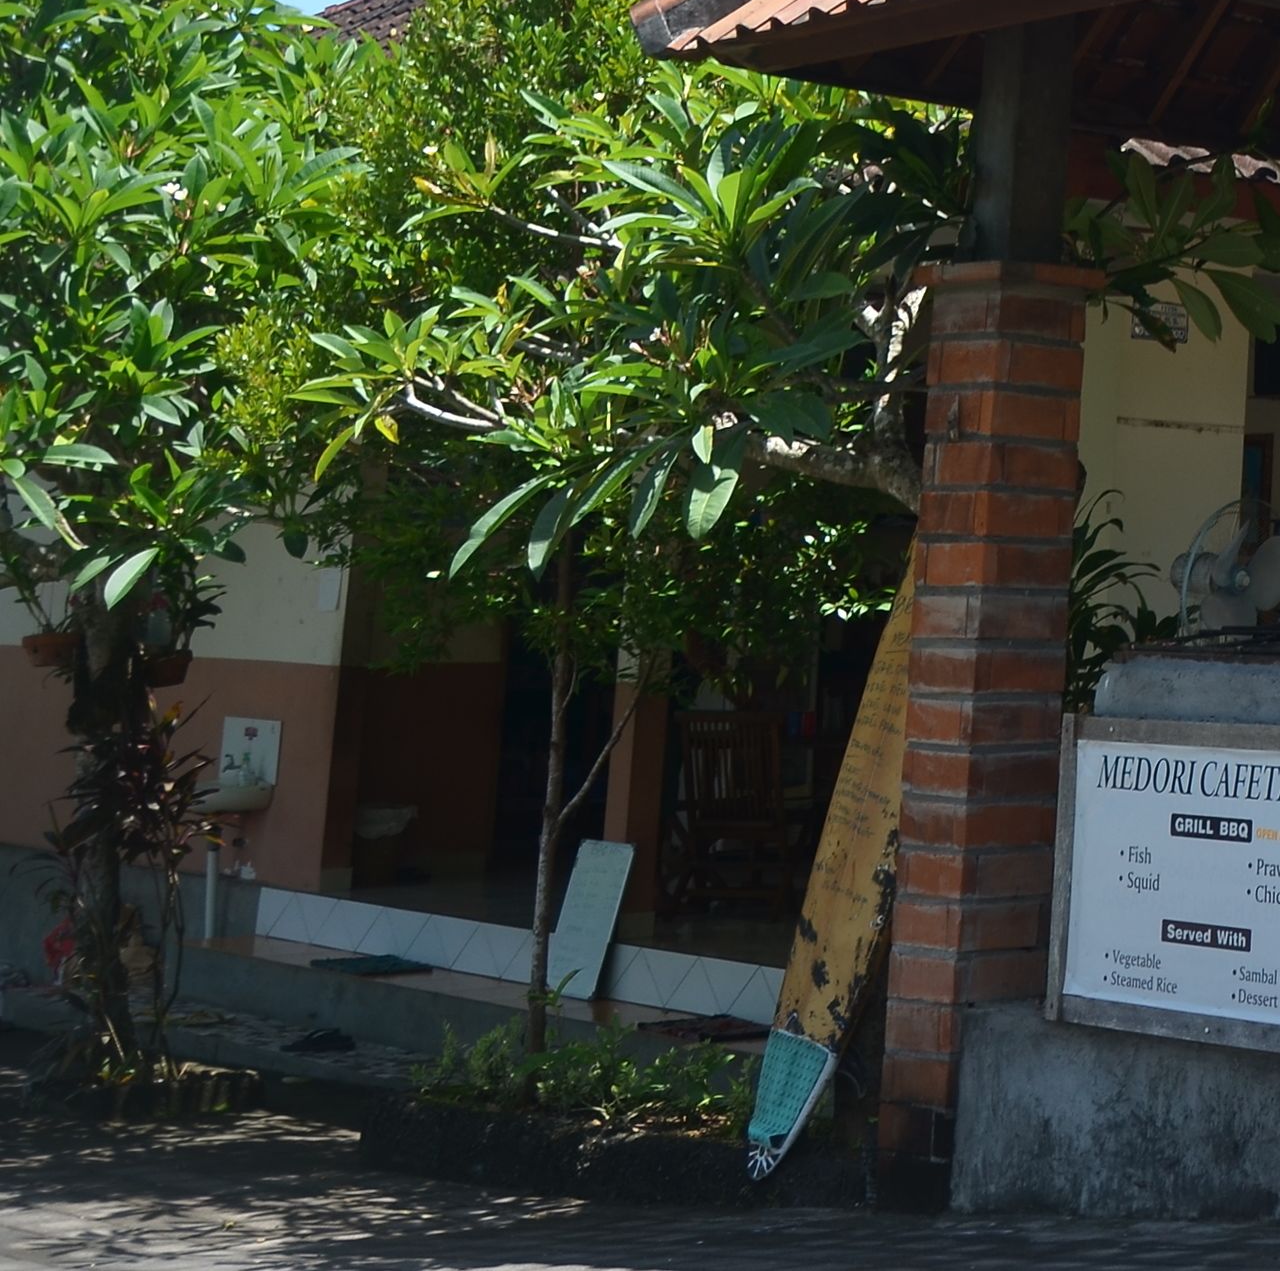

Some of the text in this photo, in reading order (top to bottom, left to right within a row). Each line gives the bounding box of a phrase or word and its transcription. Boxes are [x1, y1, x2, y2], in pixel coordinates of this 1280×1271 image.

[1097, 755, 1197, 795] MEDORI
[1175, 817, 1249, 839] GRILL BBQ
[1256, 827, 1278, 840] OPEN
[1128, 846, 1152, 864] Fish
[1127, 871, 1160, 894] Squid
[1167, 924, 1246, 948] Served With
[1112, 949, 1162, 970] Vegetable
[1110, 971, 1178, 994] Steamed Rice
[1239, 966, 1278, 985] Sambal
[1238, 988, 1278, 1008] Dessert
